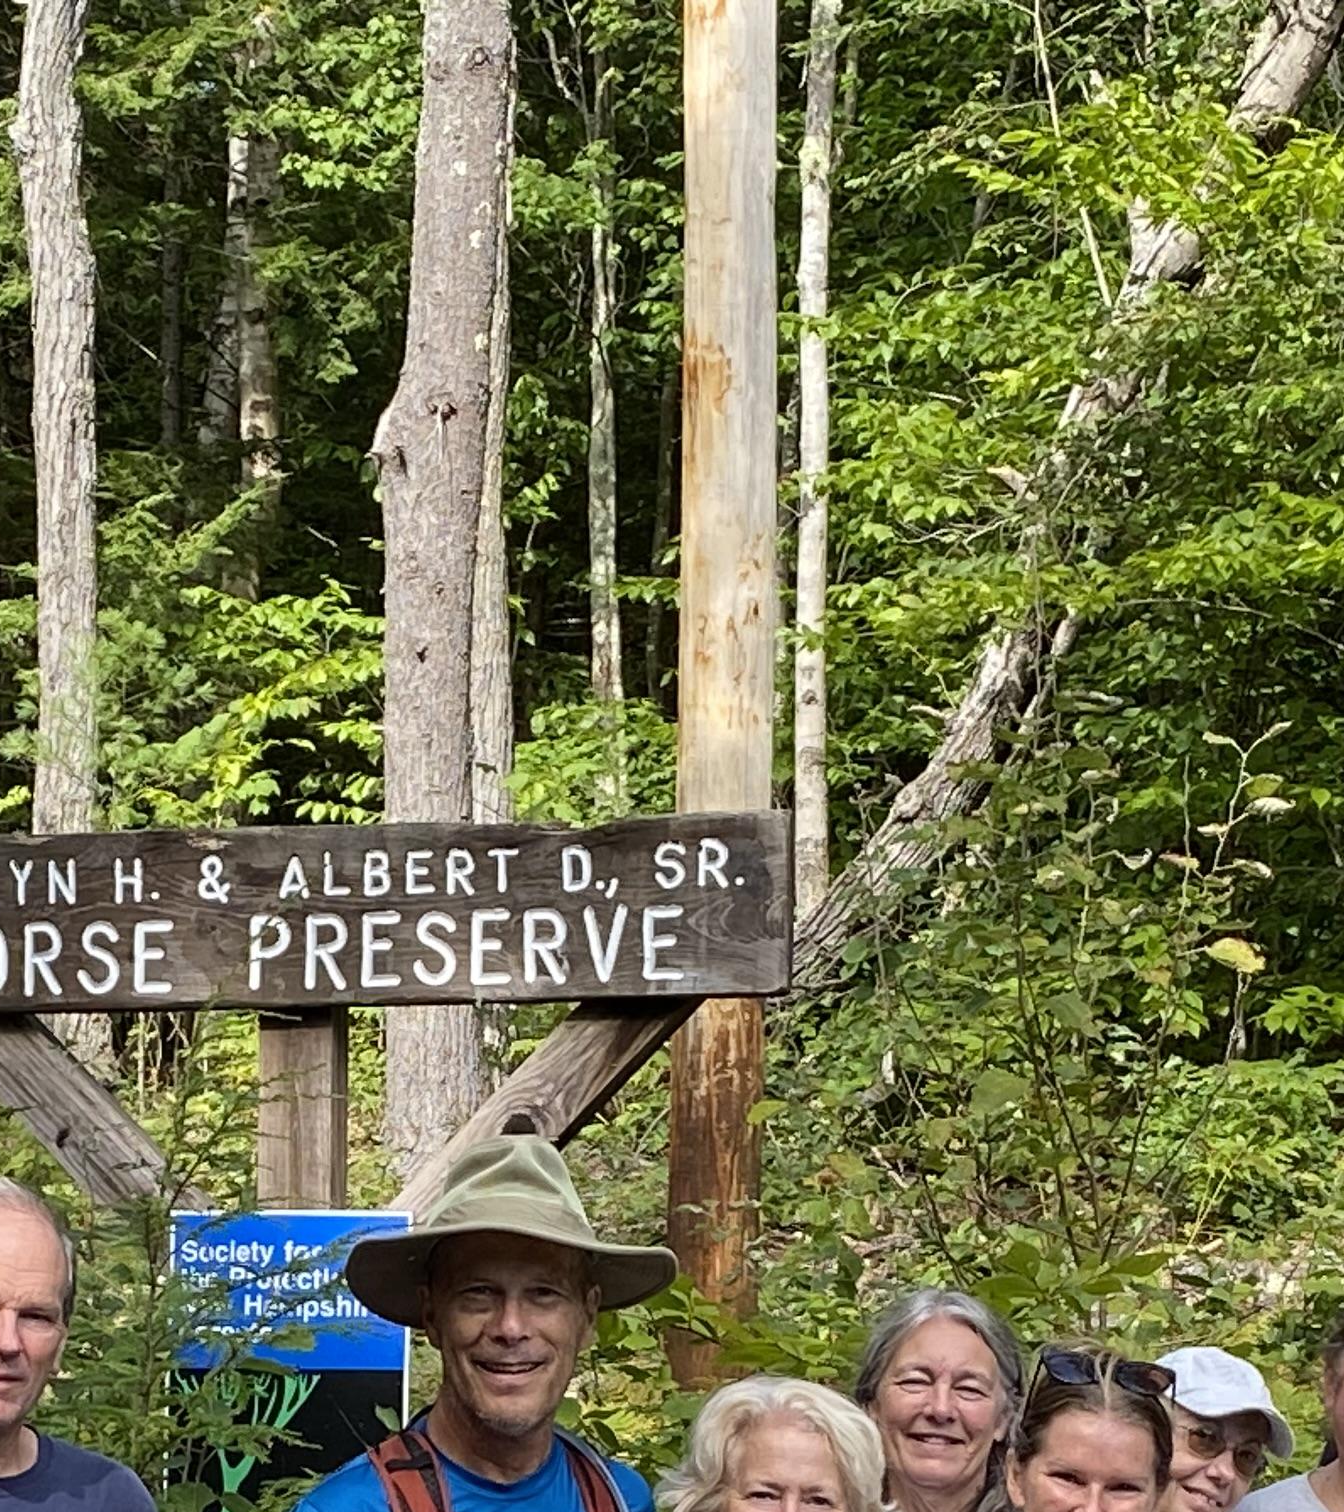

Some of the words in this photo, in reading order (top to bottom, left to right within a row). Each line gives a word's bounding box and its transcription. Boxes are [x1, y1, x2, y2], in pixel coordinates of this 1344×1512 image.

[114, 856, 161, 904] H.
[196, 855, 232, 905] &
[278, 847, 520, 900] ALBERT
[561, 843, 620, 899] D.,
[653, 837, 746, 889] SR.
[248, 903, 685, 991] PRESERVE
[181, 1239, 275, 1268] Society
